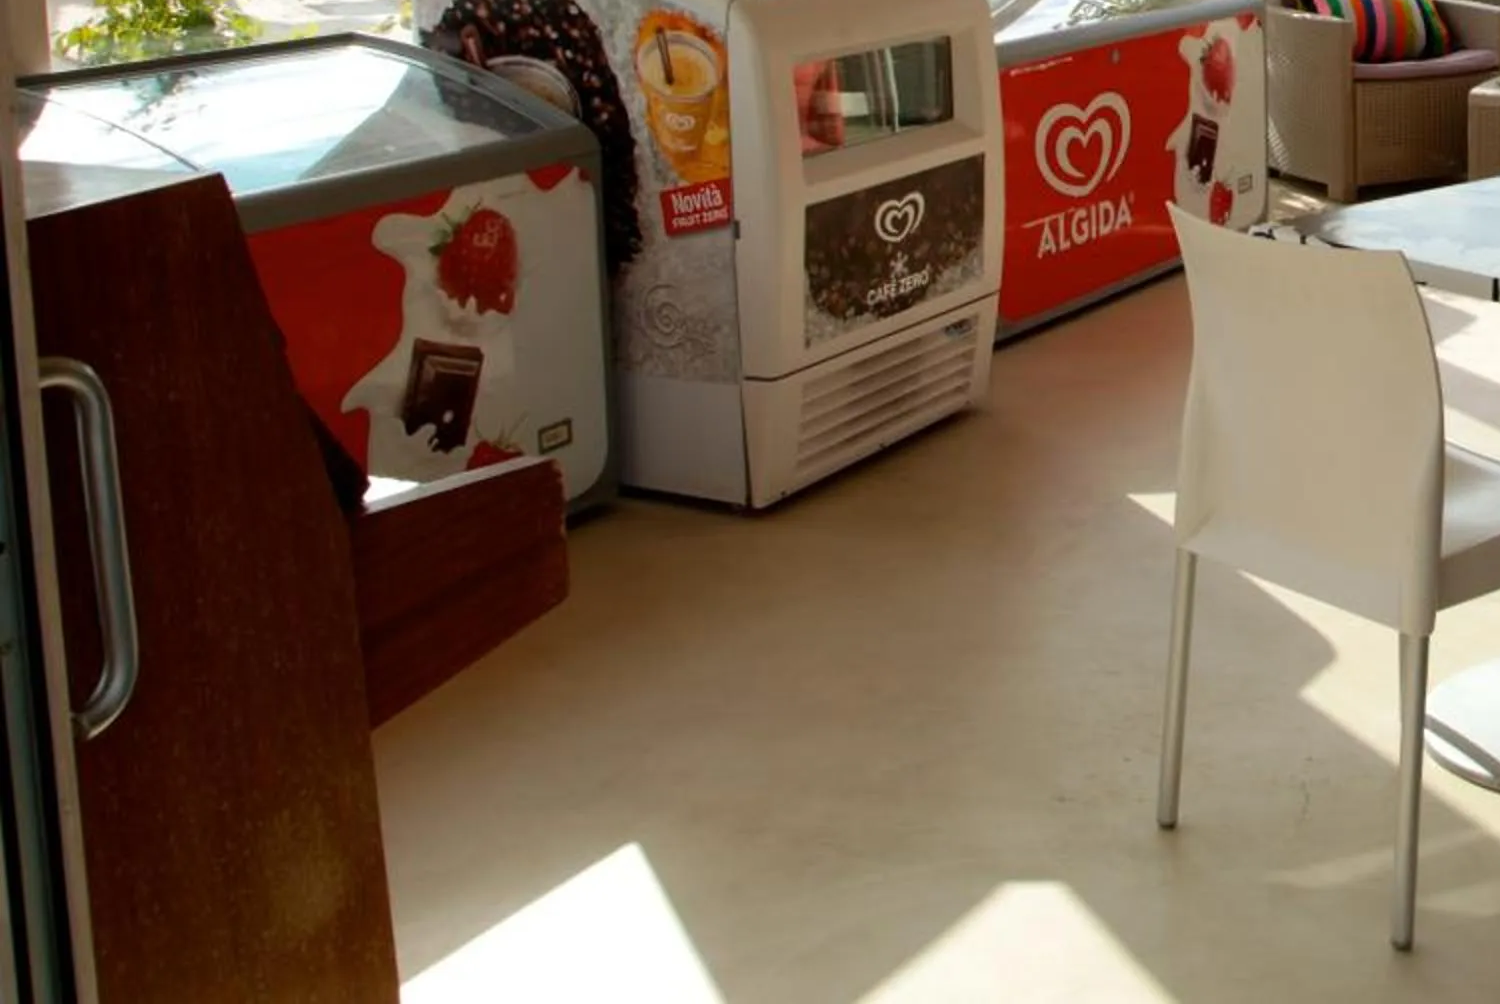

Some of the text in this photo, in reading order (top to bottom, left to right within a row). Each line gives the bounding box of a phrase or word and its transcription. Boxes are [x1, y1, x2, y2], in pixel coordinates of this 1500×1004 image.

[671, 183, 723, 214] Novità
[1021, 195, 1133, 259] ALGIDA
[898, 269, 929, 294] ZERO
